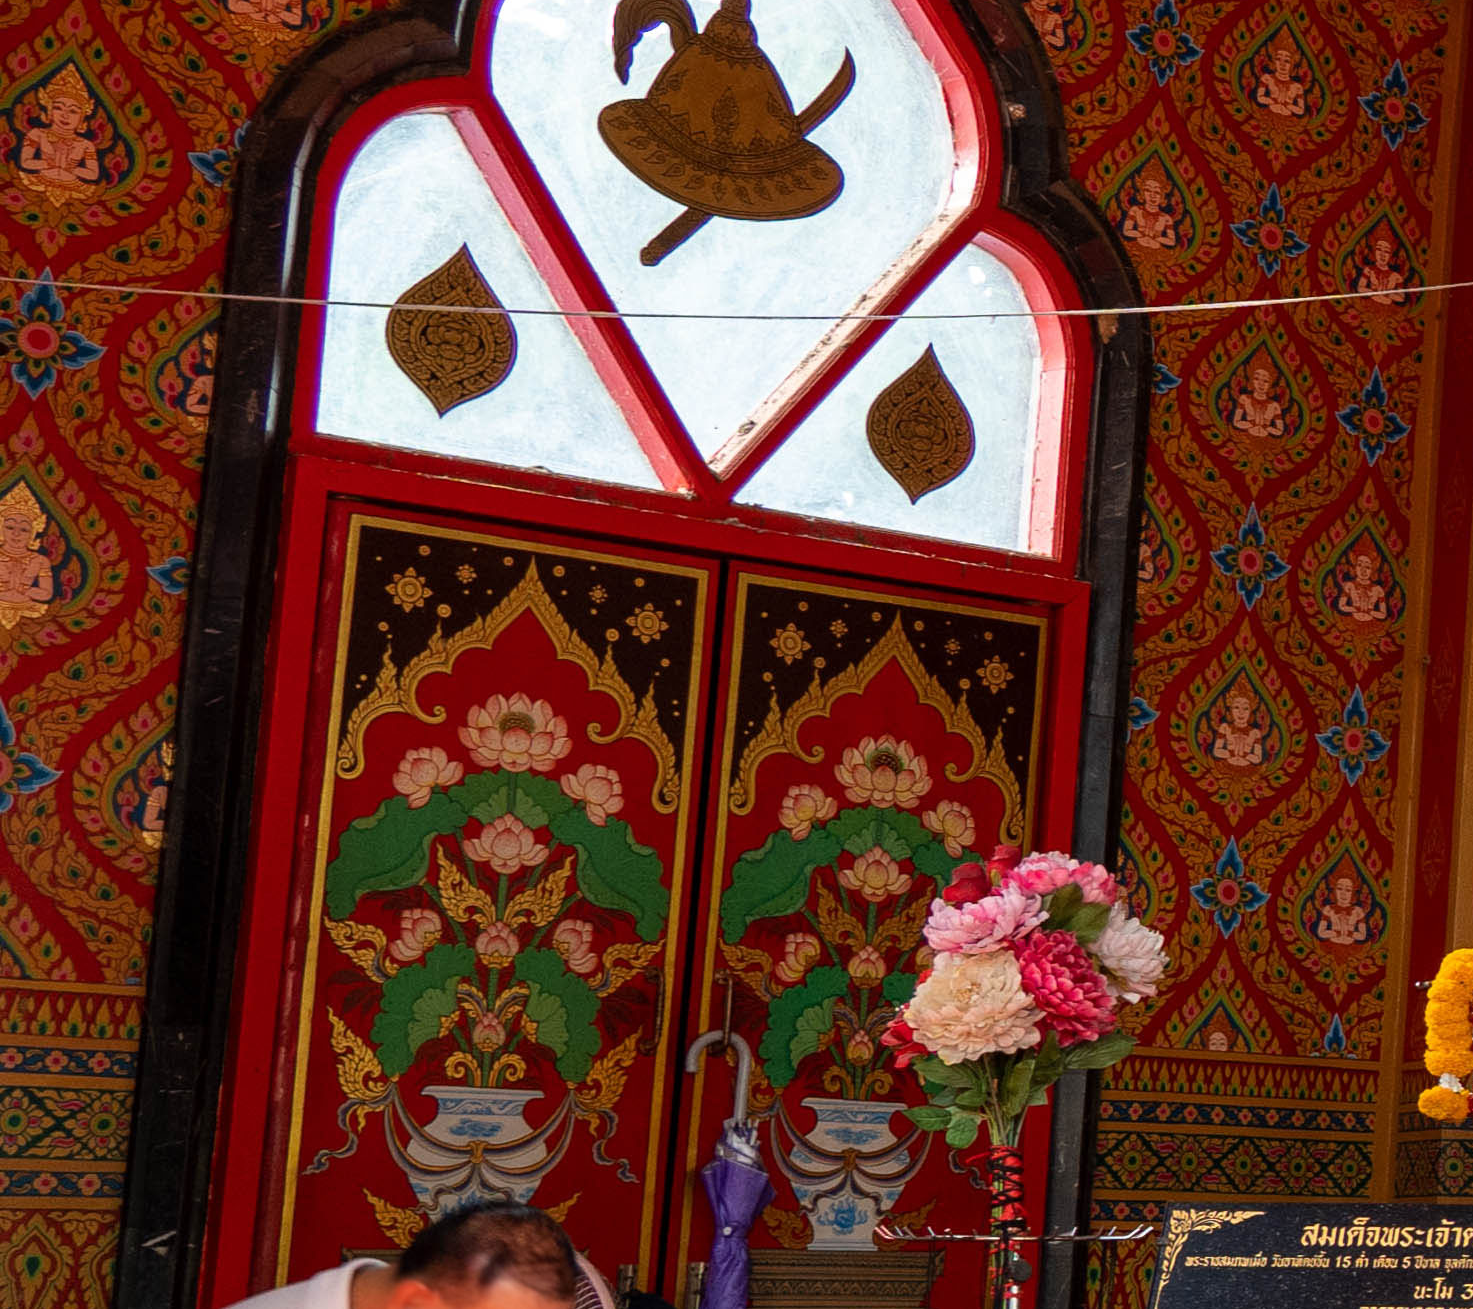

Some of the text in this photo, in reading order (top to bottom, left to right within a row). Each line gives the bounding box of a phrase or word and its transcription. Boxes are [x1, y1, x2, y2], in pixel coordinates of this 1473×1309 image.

[1335, 1256, 1351, 1268] 15
[1402, 1257, 1411, 1268] 5
[1413, 1277, 1453, 1300] นะโม
